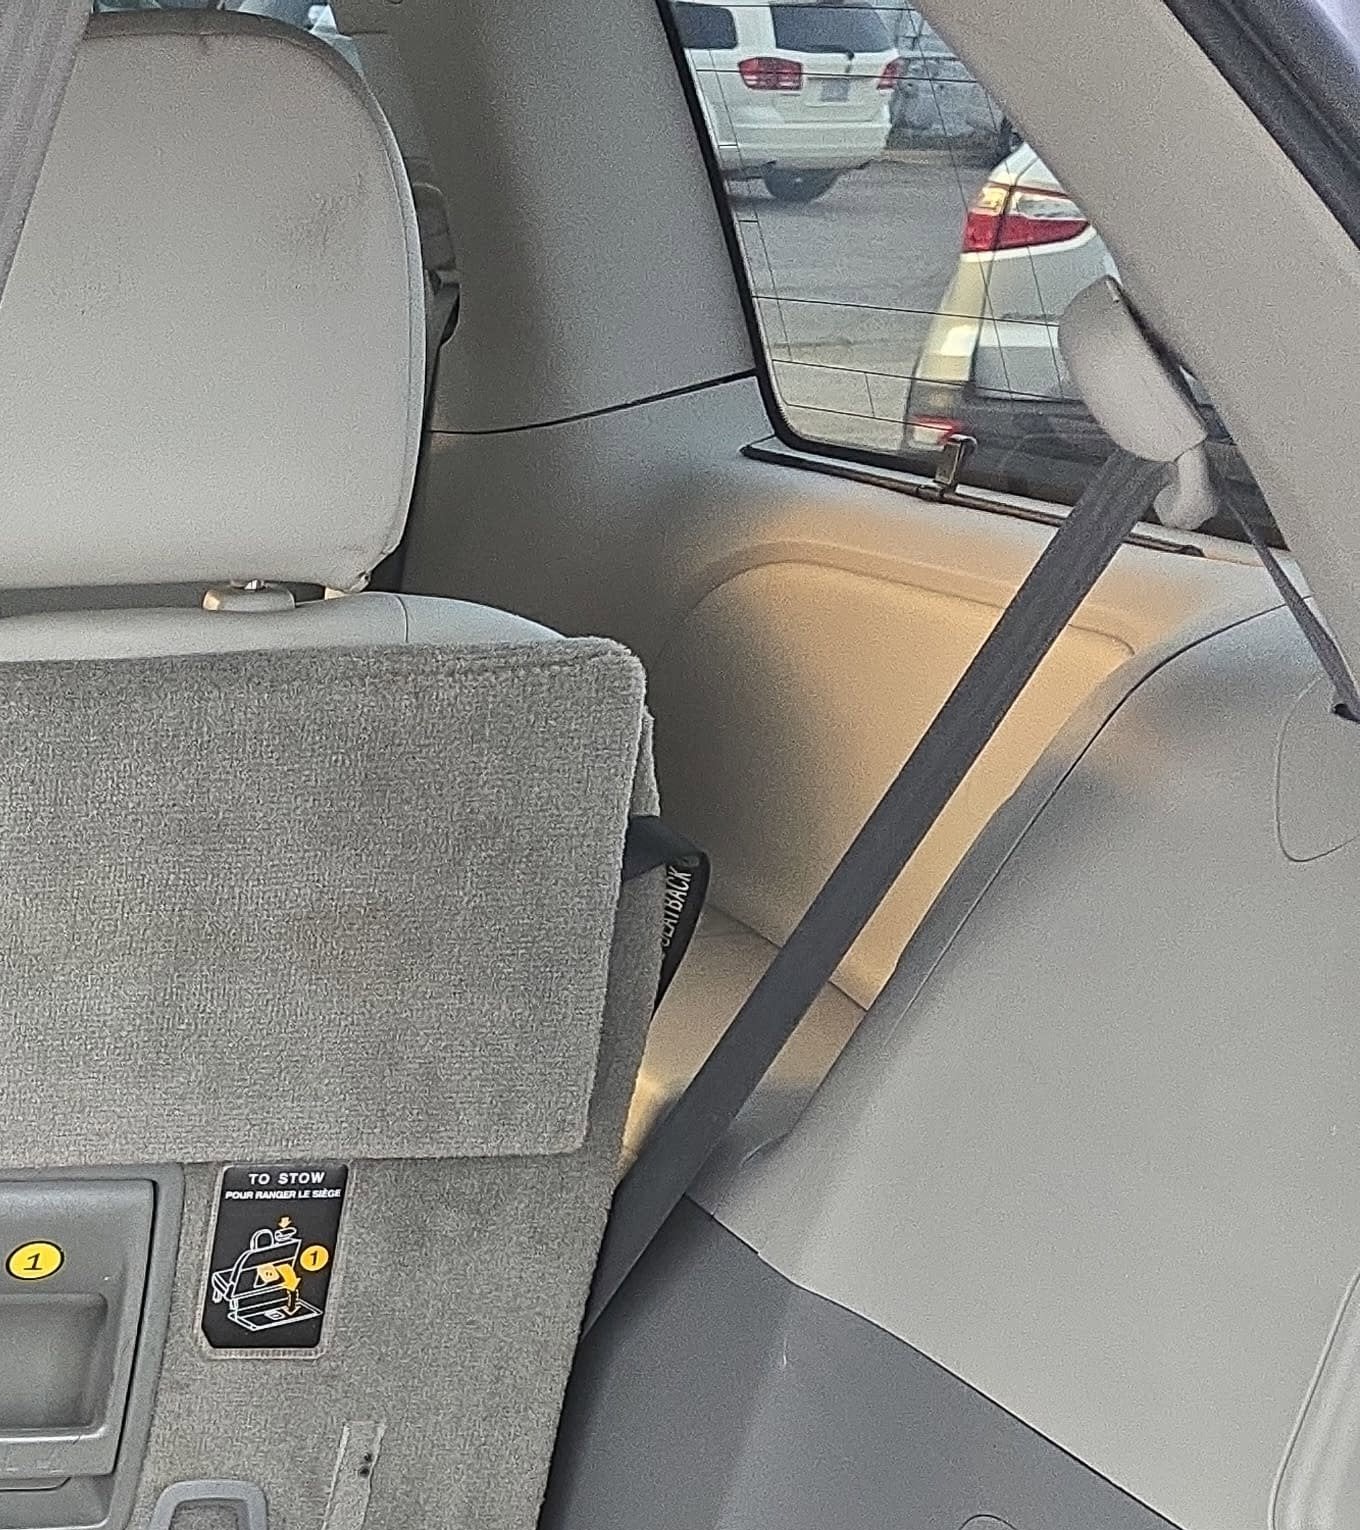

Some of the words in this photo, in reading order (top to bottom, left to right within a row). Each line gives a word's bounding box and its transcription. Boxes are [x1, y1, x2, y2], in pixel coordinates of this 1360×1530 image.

[248, 1173, 270, 1185] TO
[278, 1172, 325, 1184] STOW
[225, 1191, 253, 1200] POUR
[255, 1190, 296, 1199] RANGER
[298, 1190, 310, 1198] LE
[23, 1253, 42, 1270] 1
[309, 1250, 318, 1266] 1
